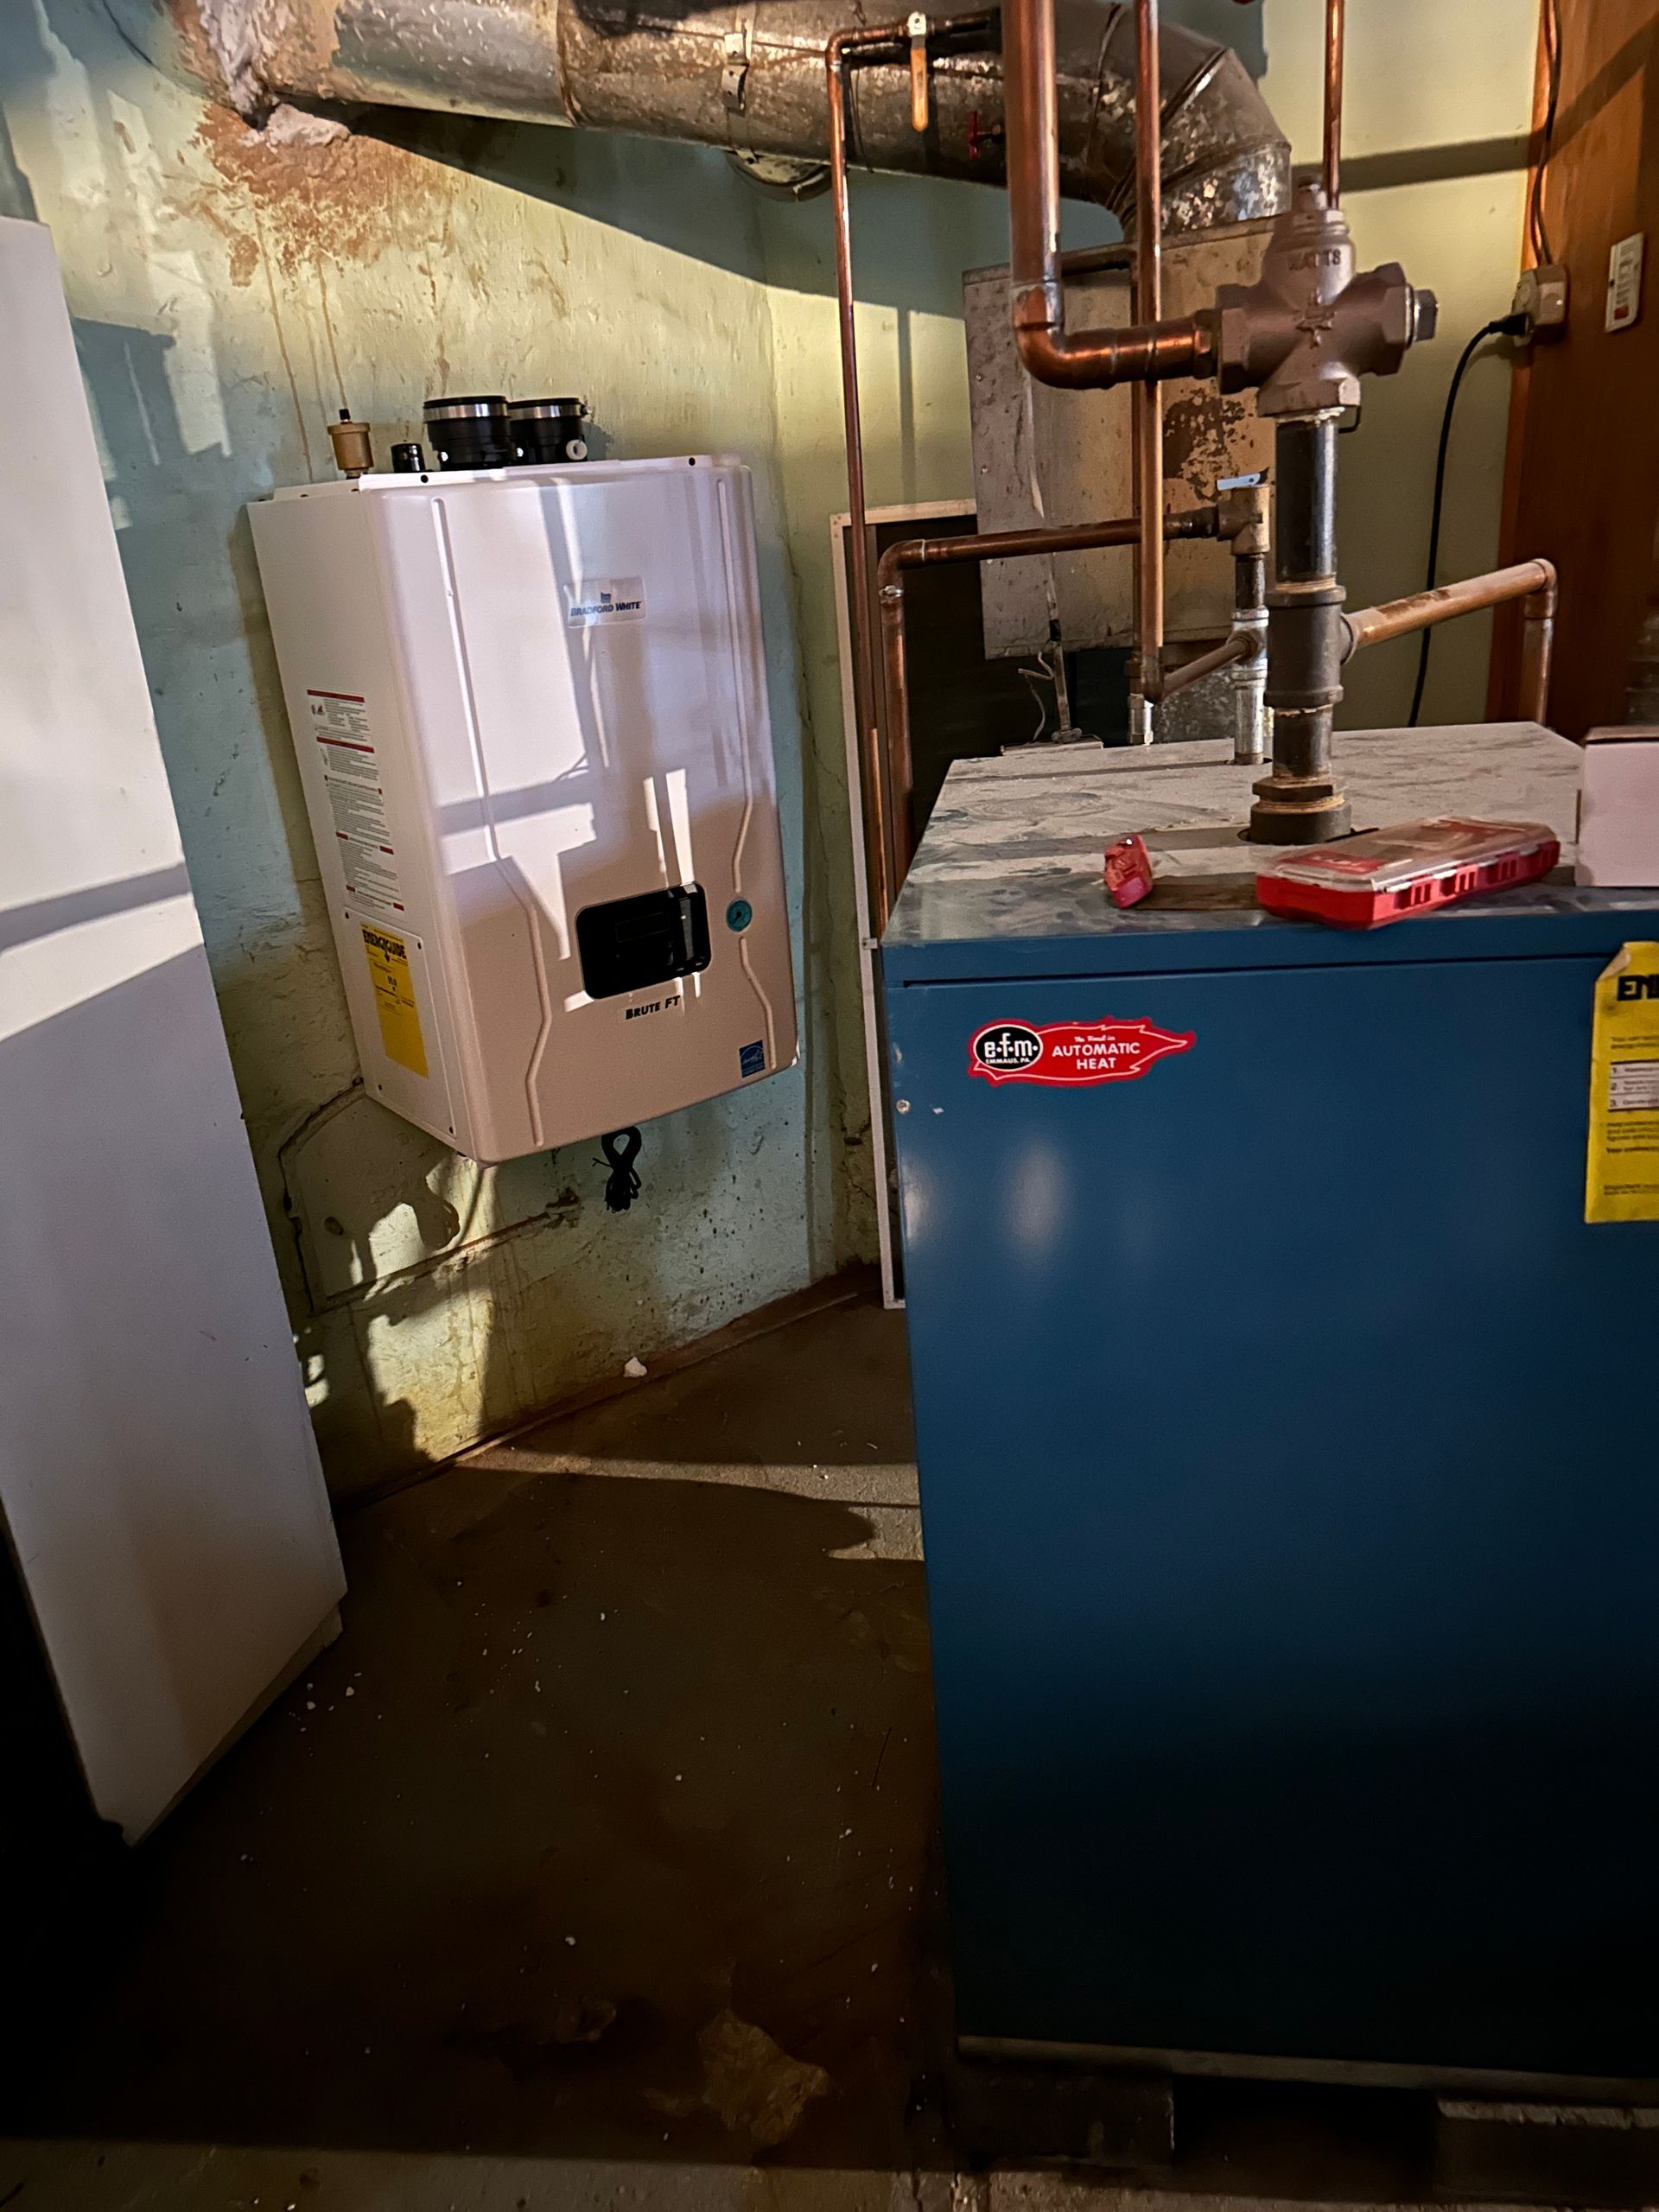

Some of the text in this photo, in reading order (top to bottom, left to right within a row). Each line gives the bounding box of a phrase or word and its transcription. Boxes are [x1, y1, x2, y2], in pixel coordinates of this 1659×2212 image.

[570, 601, 640, 616] BRADFORD WHITE
[664, 995, 681, 1009] FT
[1052, 1042, 1141, 1058] AUTOMATIC
[1077, 1058, 1116, 1070] HEAT
